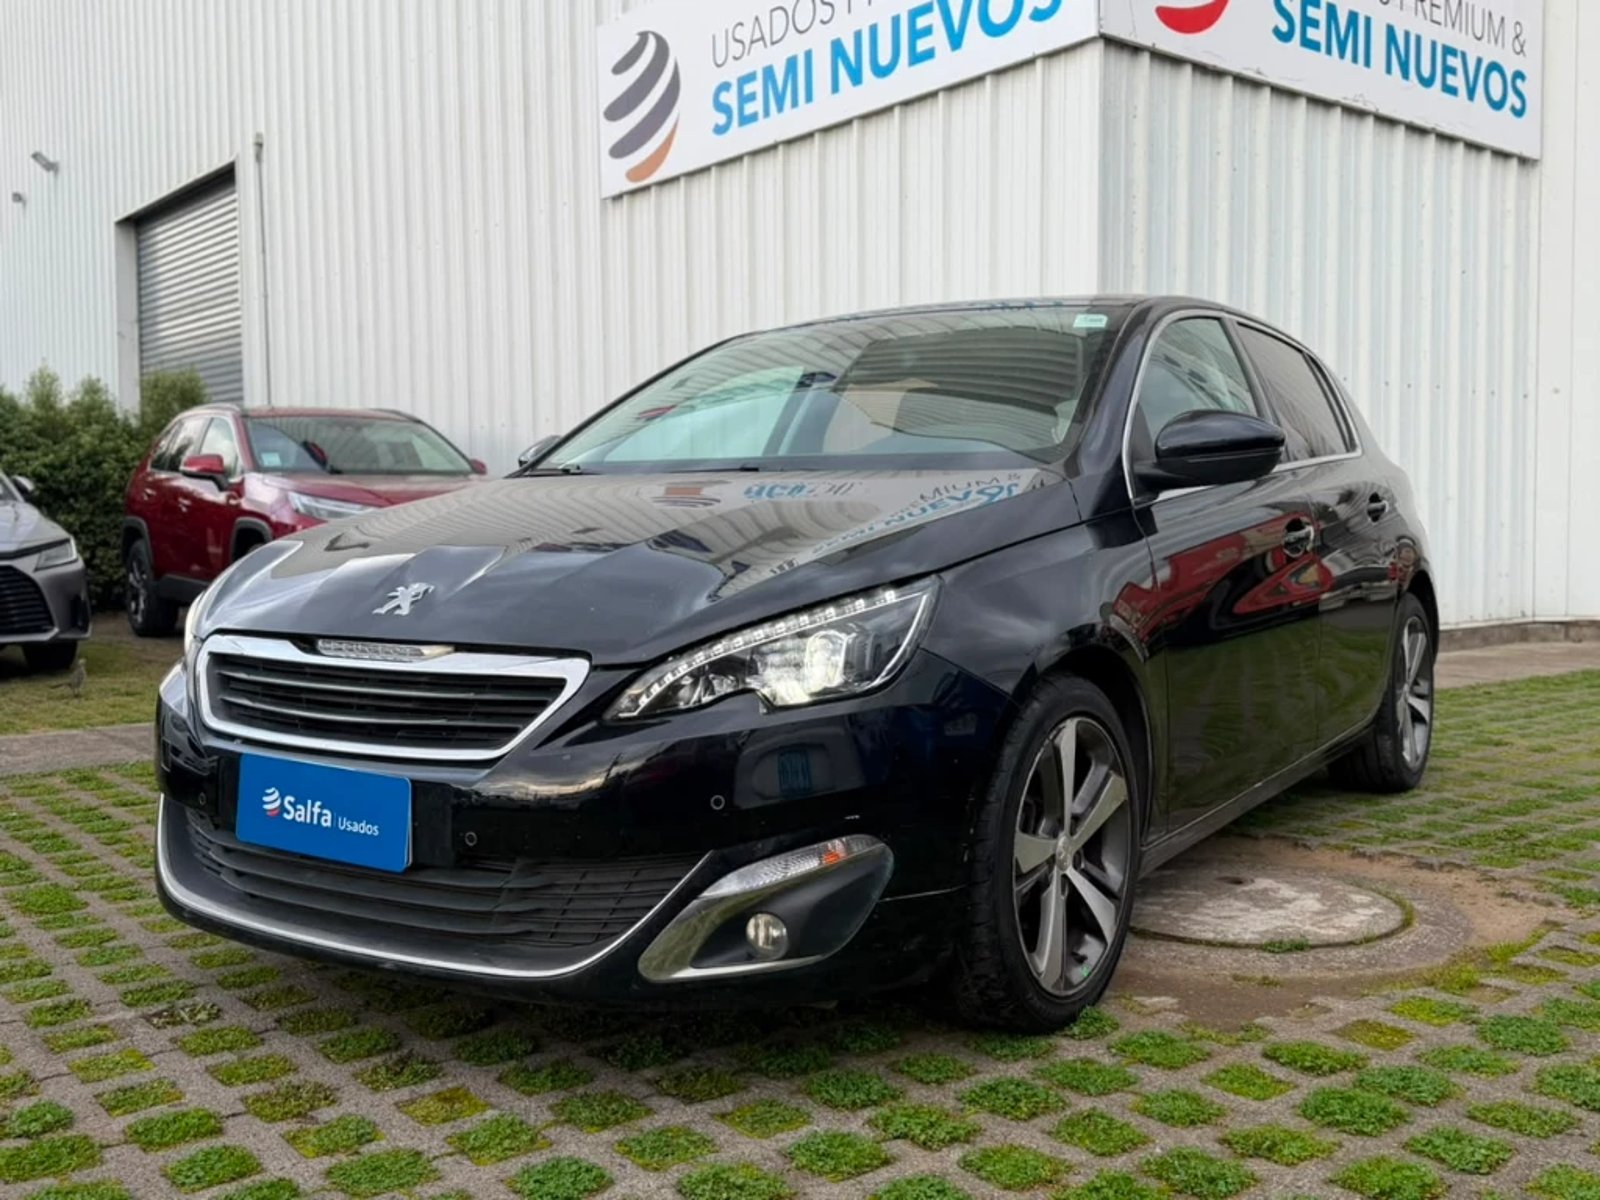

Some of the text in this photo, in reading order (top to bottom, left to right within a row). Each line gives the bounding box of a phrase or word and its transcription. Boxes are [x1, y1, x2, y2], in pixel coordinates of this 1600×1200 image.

[712, 0, 835, 68] USADOS
[1271, 0, 1527, 118] SEMI NUEVOS
[1511, 20, 1527, 57] &
[712, 49, 813, 136] SEMI
[283, 795, 379, 836] Salfa Usados
